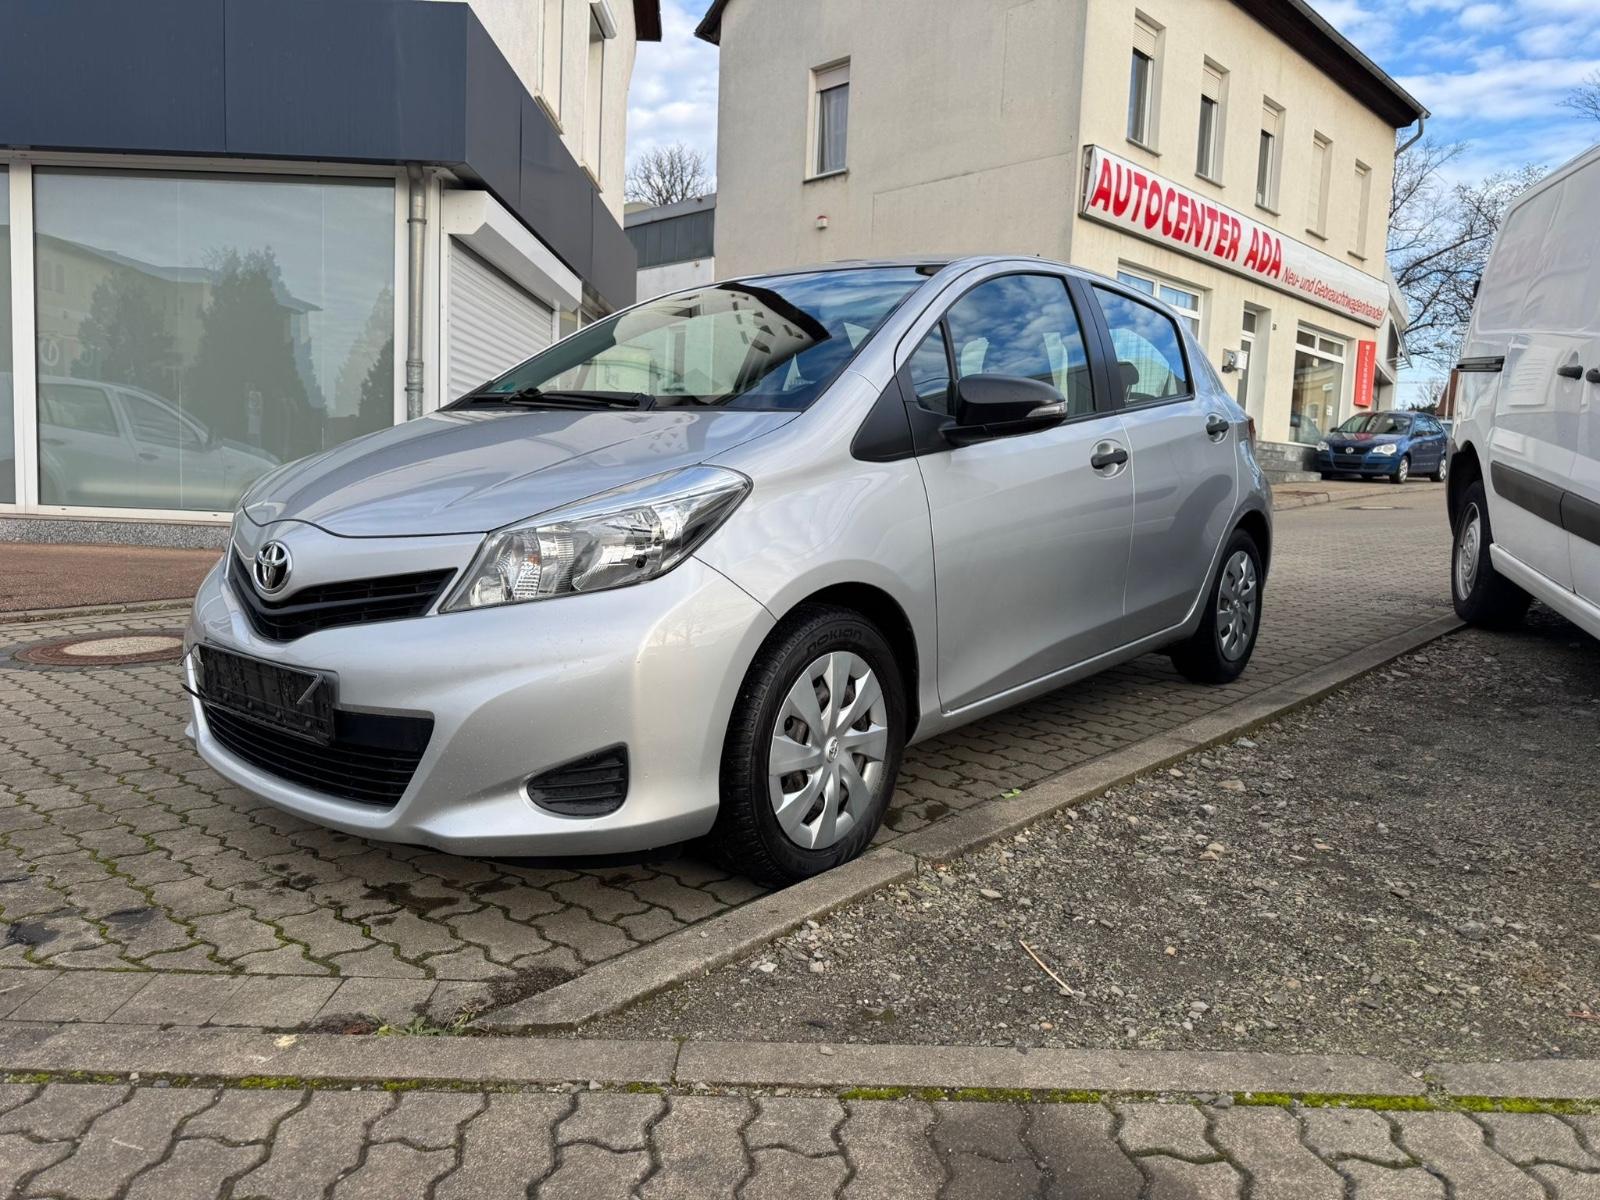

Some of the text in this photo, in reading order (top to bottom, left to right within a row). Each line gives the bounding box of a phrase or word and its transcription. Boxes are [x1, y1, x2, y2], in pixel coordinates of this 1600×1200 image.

[1091, 157, 1282, 280] AUTOCENTER ADA
[1282, 266, 1386, 321] Neu- und Gebrauchtwagenhandel
